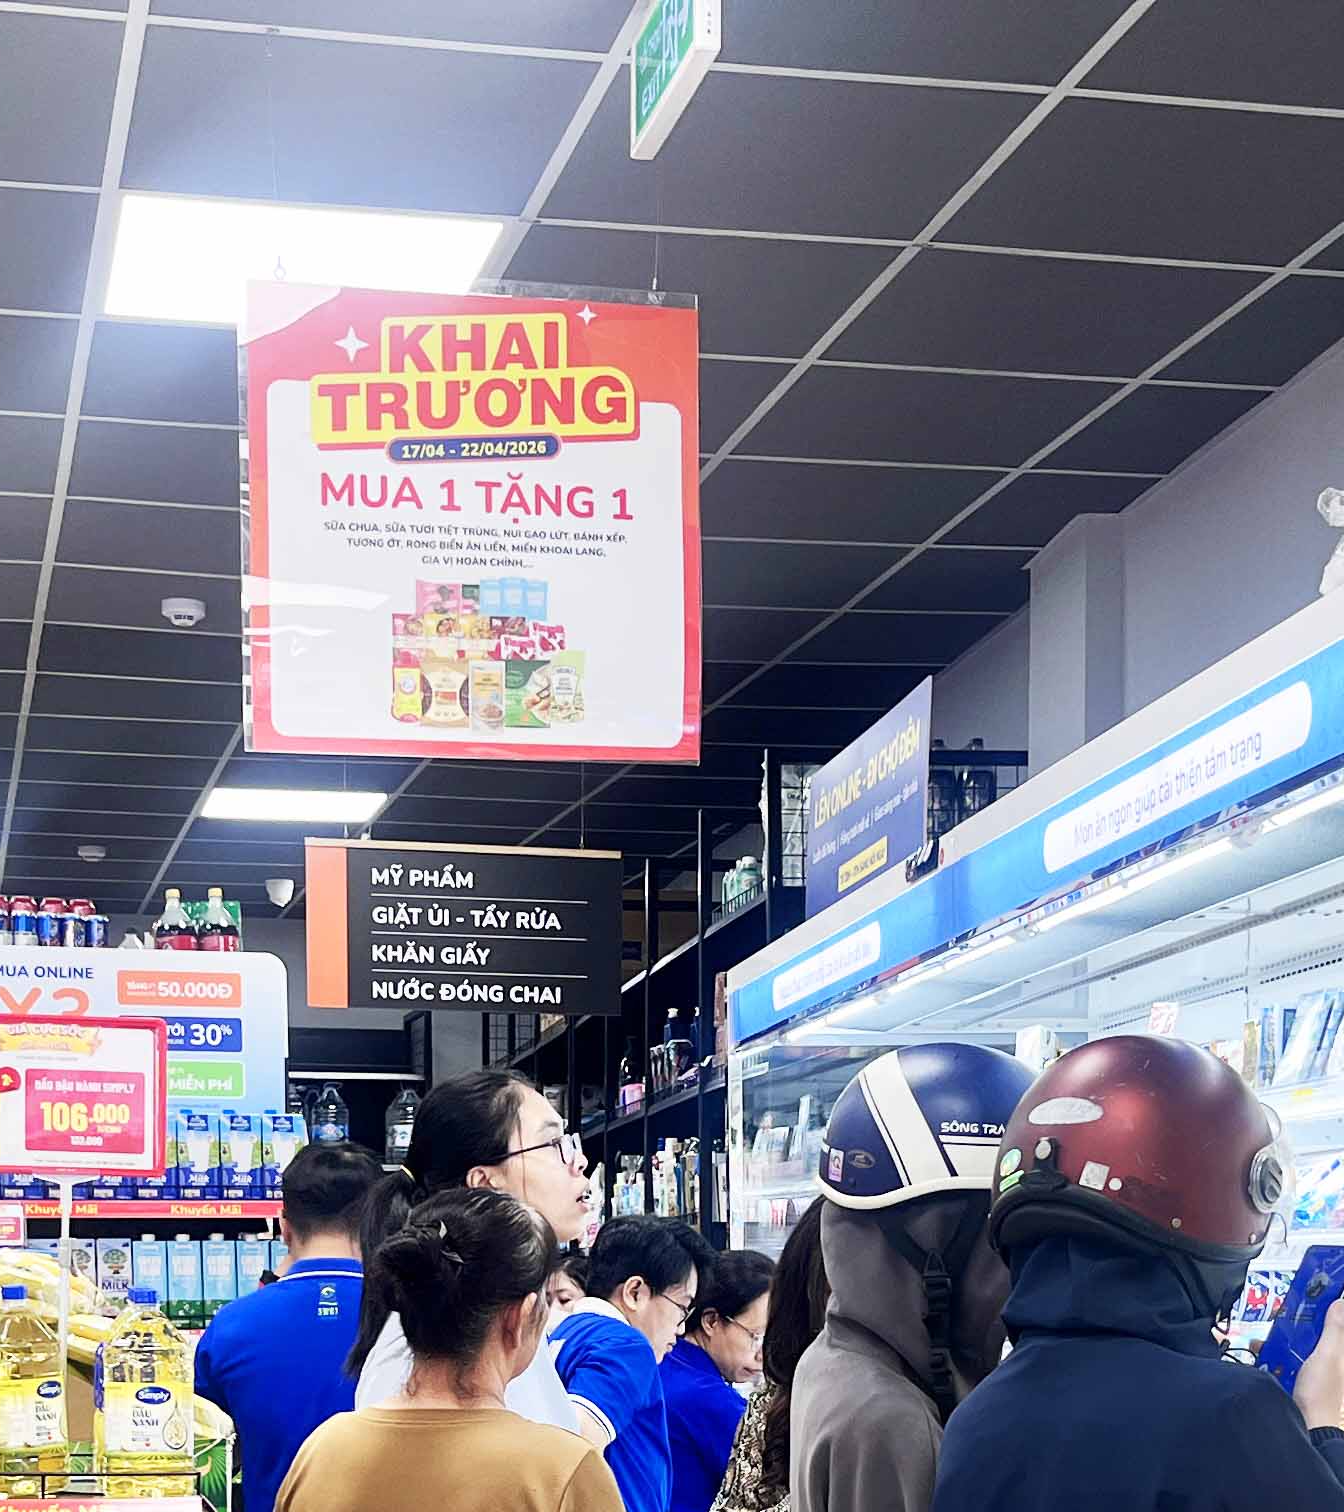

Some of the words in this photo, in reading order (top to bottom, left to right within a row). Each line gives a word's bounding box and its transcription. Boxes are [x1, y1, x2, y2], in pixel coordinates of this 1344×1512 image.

[387, 321, 560, 373] KHAI
[317, 376, 628, 432] TRƯƠNG
[401, 445, 445, 458] 17/04
[460, 441, 547, 457] 22/04/2026
[320, 472, 423, 509] MUA
[440, 479, 461, 512] 1
[474, 471, 595, 524] TẶNG
[612, 488, 634, 520] 1
[371, 865, 404, 887] MỸ
[409, 864, 474, 889] PHẨM
[372, 902, 422, 930] GIẶT
[427, 903, 450, 927] ỦI
[470, 904, 510, 928] TẨY
[515, 907, 561, 930] RỬA
[371, 941, 435, 965] KHĂN
[440, 941, 490, 966] GIẤY
[34, 966, 94, 979] ONLINE
[157, 981, 233, 998] 50.000Đ
[372, 977, 435, 1001] NƯỚC
[439, 981, 504, 1003] ĐÓNG
[509, 986, 561, 1004] CHAI
[40, 1102, 130, 1132] 106.000
[940, 1120, 980, 1135] SÔNG
[76, 1204, 98, 1216] Mãi
[171, 1204, 216, 1218] Khuyến
[220, 1204, 242, 1216] Mãi
[102, 1282, 129, 1291] MILK
